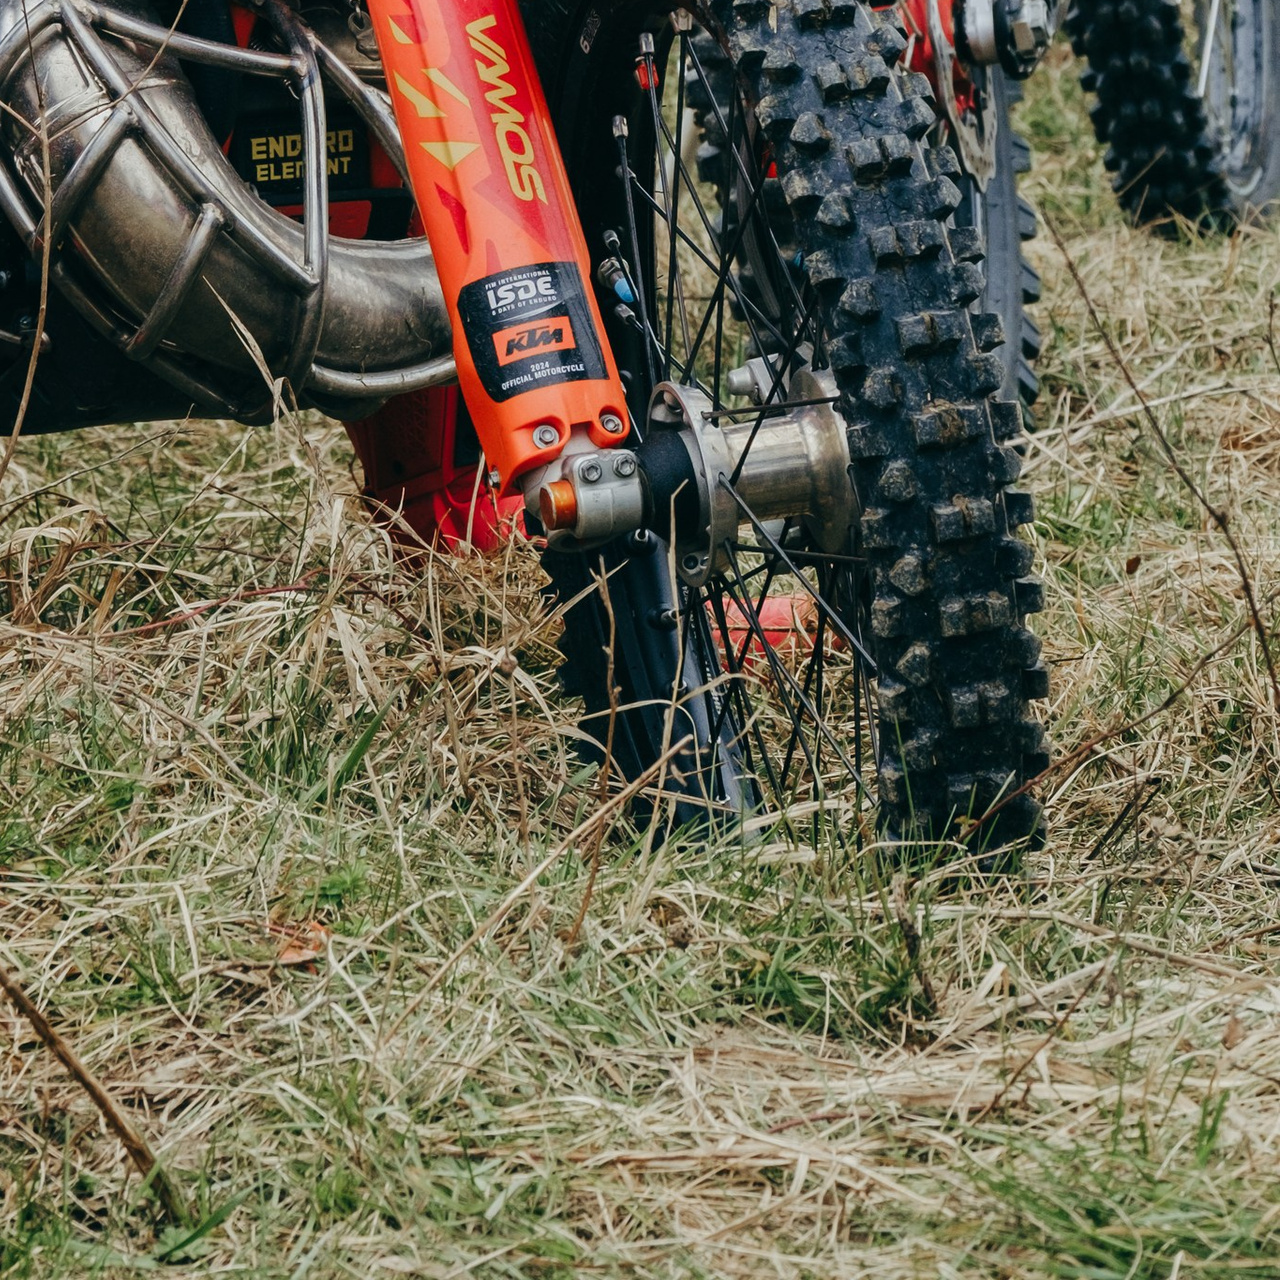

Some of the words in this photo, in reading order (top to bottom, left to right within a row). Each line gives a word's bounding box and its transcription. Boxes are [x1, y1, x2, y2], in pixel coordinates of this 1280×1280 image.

[465, 14, 548, 205] VAMOS
[250, 129, 354, 160] ENDRO
[486, 276, 558, 310] ISDE
[498, 269, 550, 286] INTERNATIONAL
[505, 325, 564, 357] KTM
[501, 374, 534, 391] OFFICIAL
[534, 363, 585, 380] MOTORCYCLE
[530, 361, 550, 372] 2024
